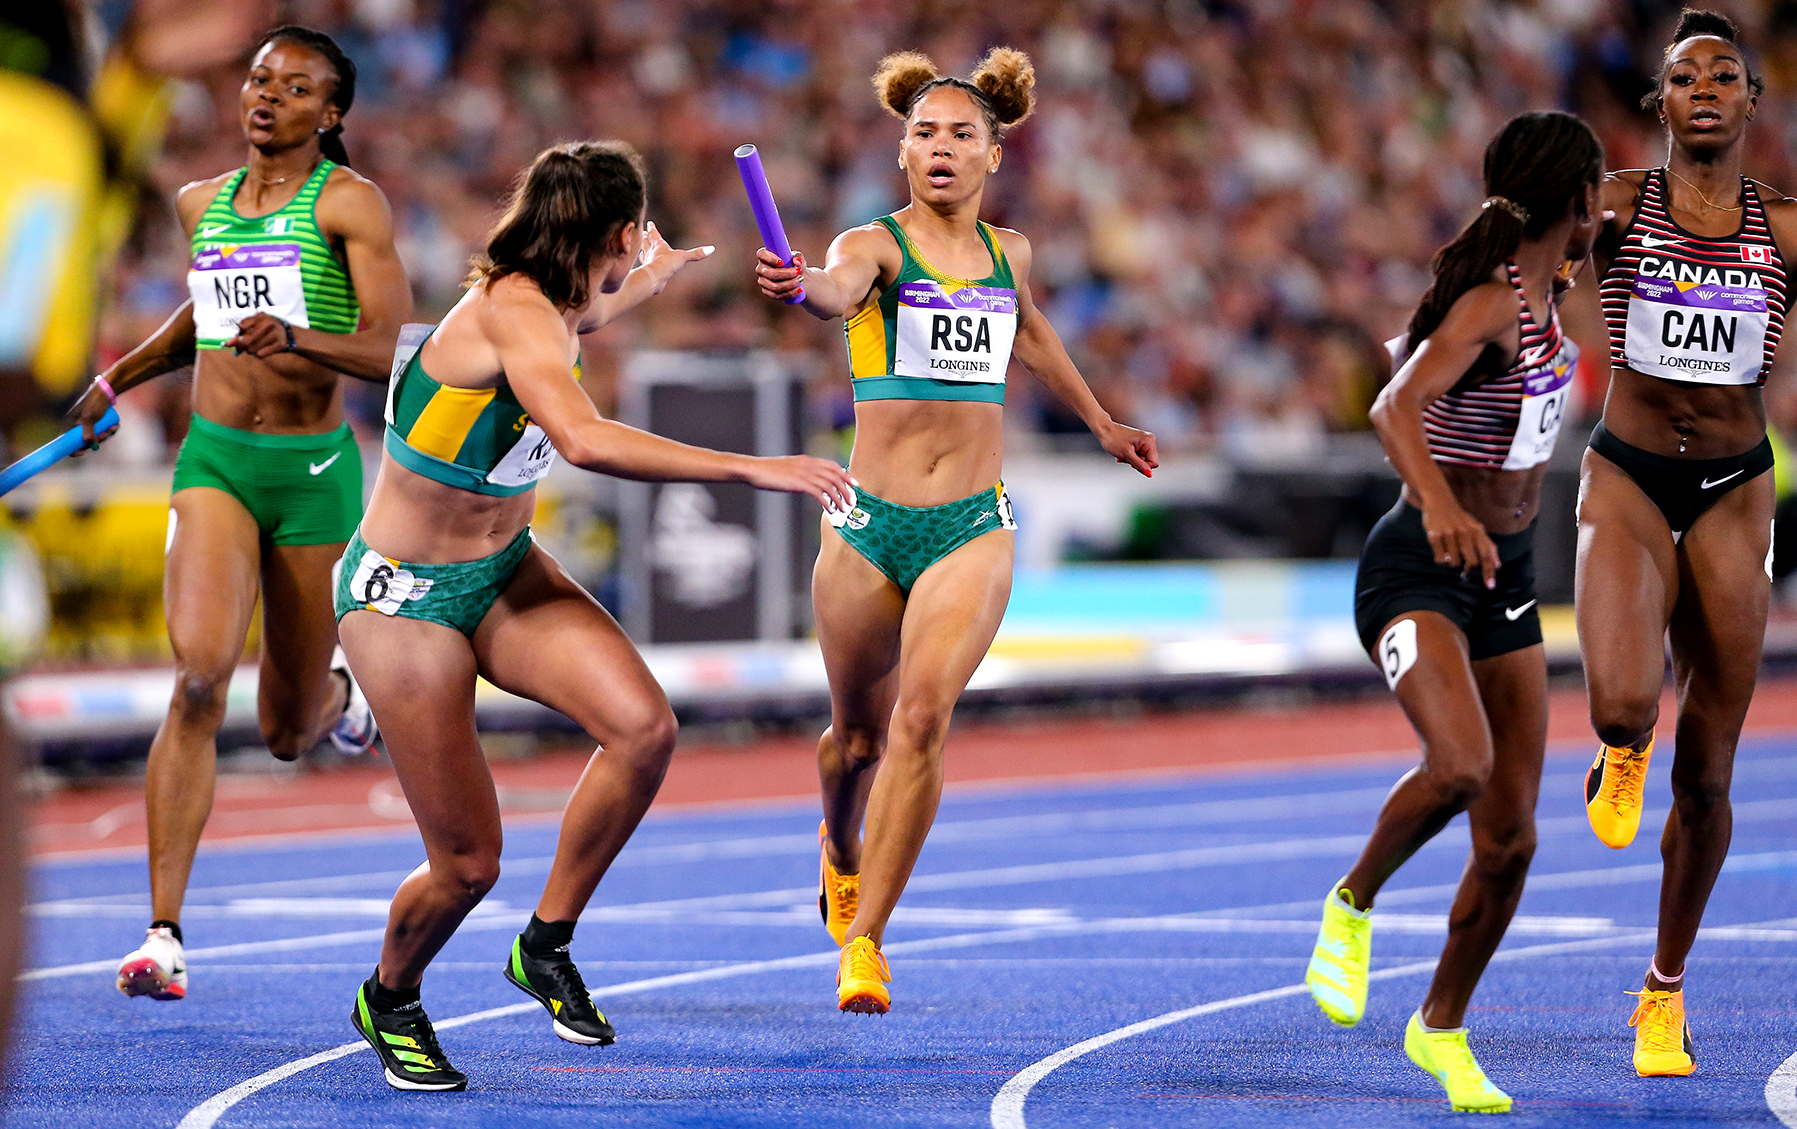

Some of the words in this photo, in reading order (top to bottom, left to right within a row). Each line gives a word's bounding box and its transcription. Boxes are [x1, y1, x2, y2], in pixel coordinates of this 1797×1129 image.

[1638, 256, 1764, 290] CANADA
[213, 274, 275, 309] NGR
[904, 289, 941, 298] BIRMINGHAM
[915, 296, 930, 304] 2022
[1646, 289, 1662, 298] 2022
[930, 314, 991, 353] RSA
[1661, 310, 1738, 353] CAN
[930, 358, 990, 372] LONGINES
[1659, 355, 1731, 372] LONGINES
[365, 564, 394, 603] 6
[1386, 631, 1400, 678] 5
